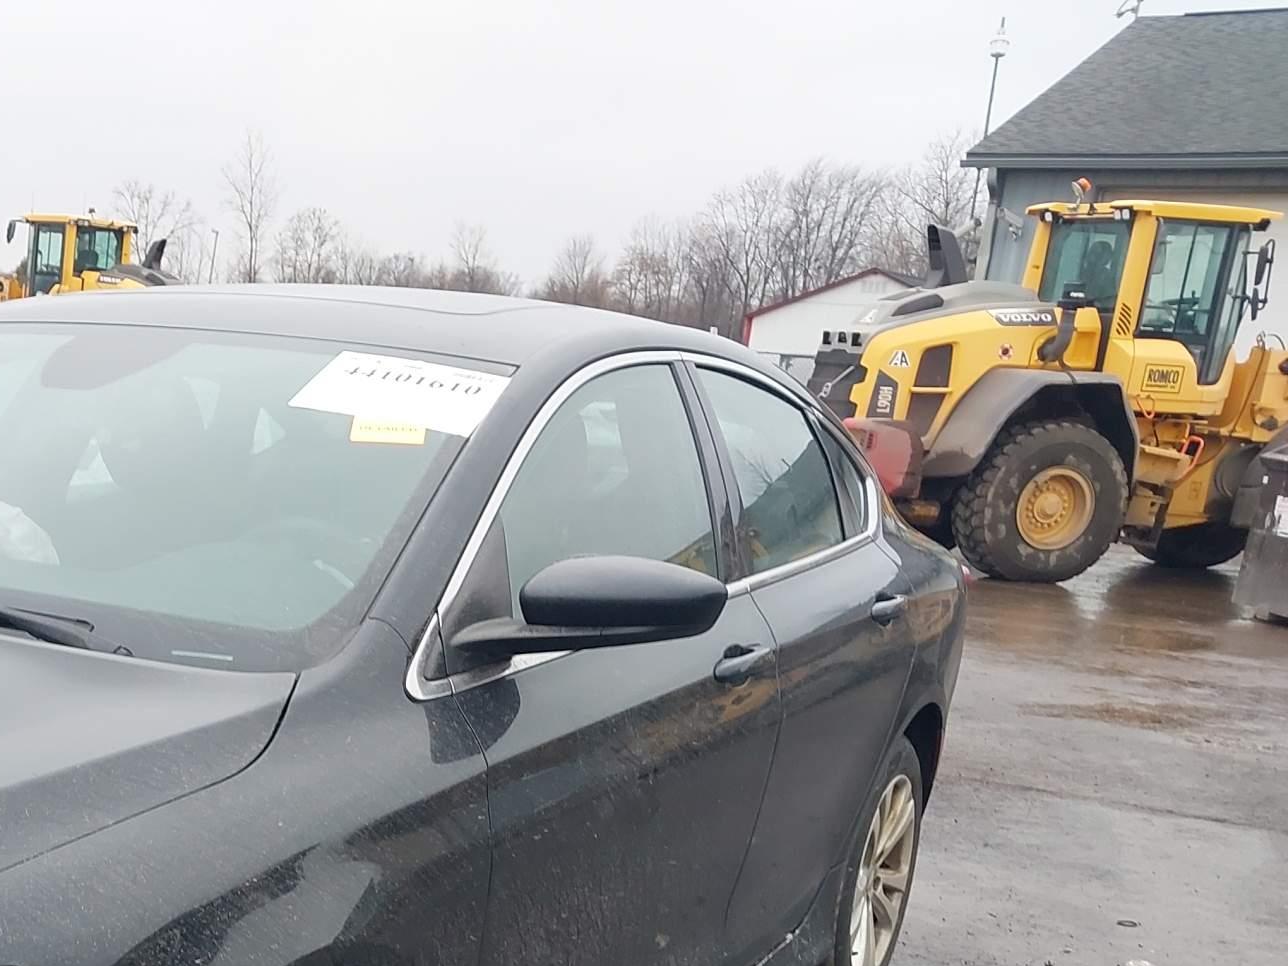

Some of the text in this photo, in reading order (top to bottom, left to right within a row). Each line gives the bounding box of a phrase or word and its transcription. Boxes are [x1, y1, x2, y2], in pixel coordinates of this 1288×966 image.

[997, 312, 1052, 322] VOLVO
[1147, 368, 1180, 385] ROMCO
[875, 386, 894, 414] L90H
